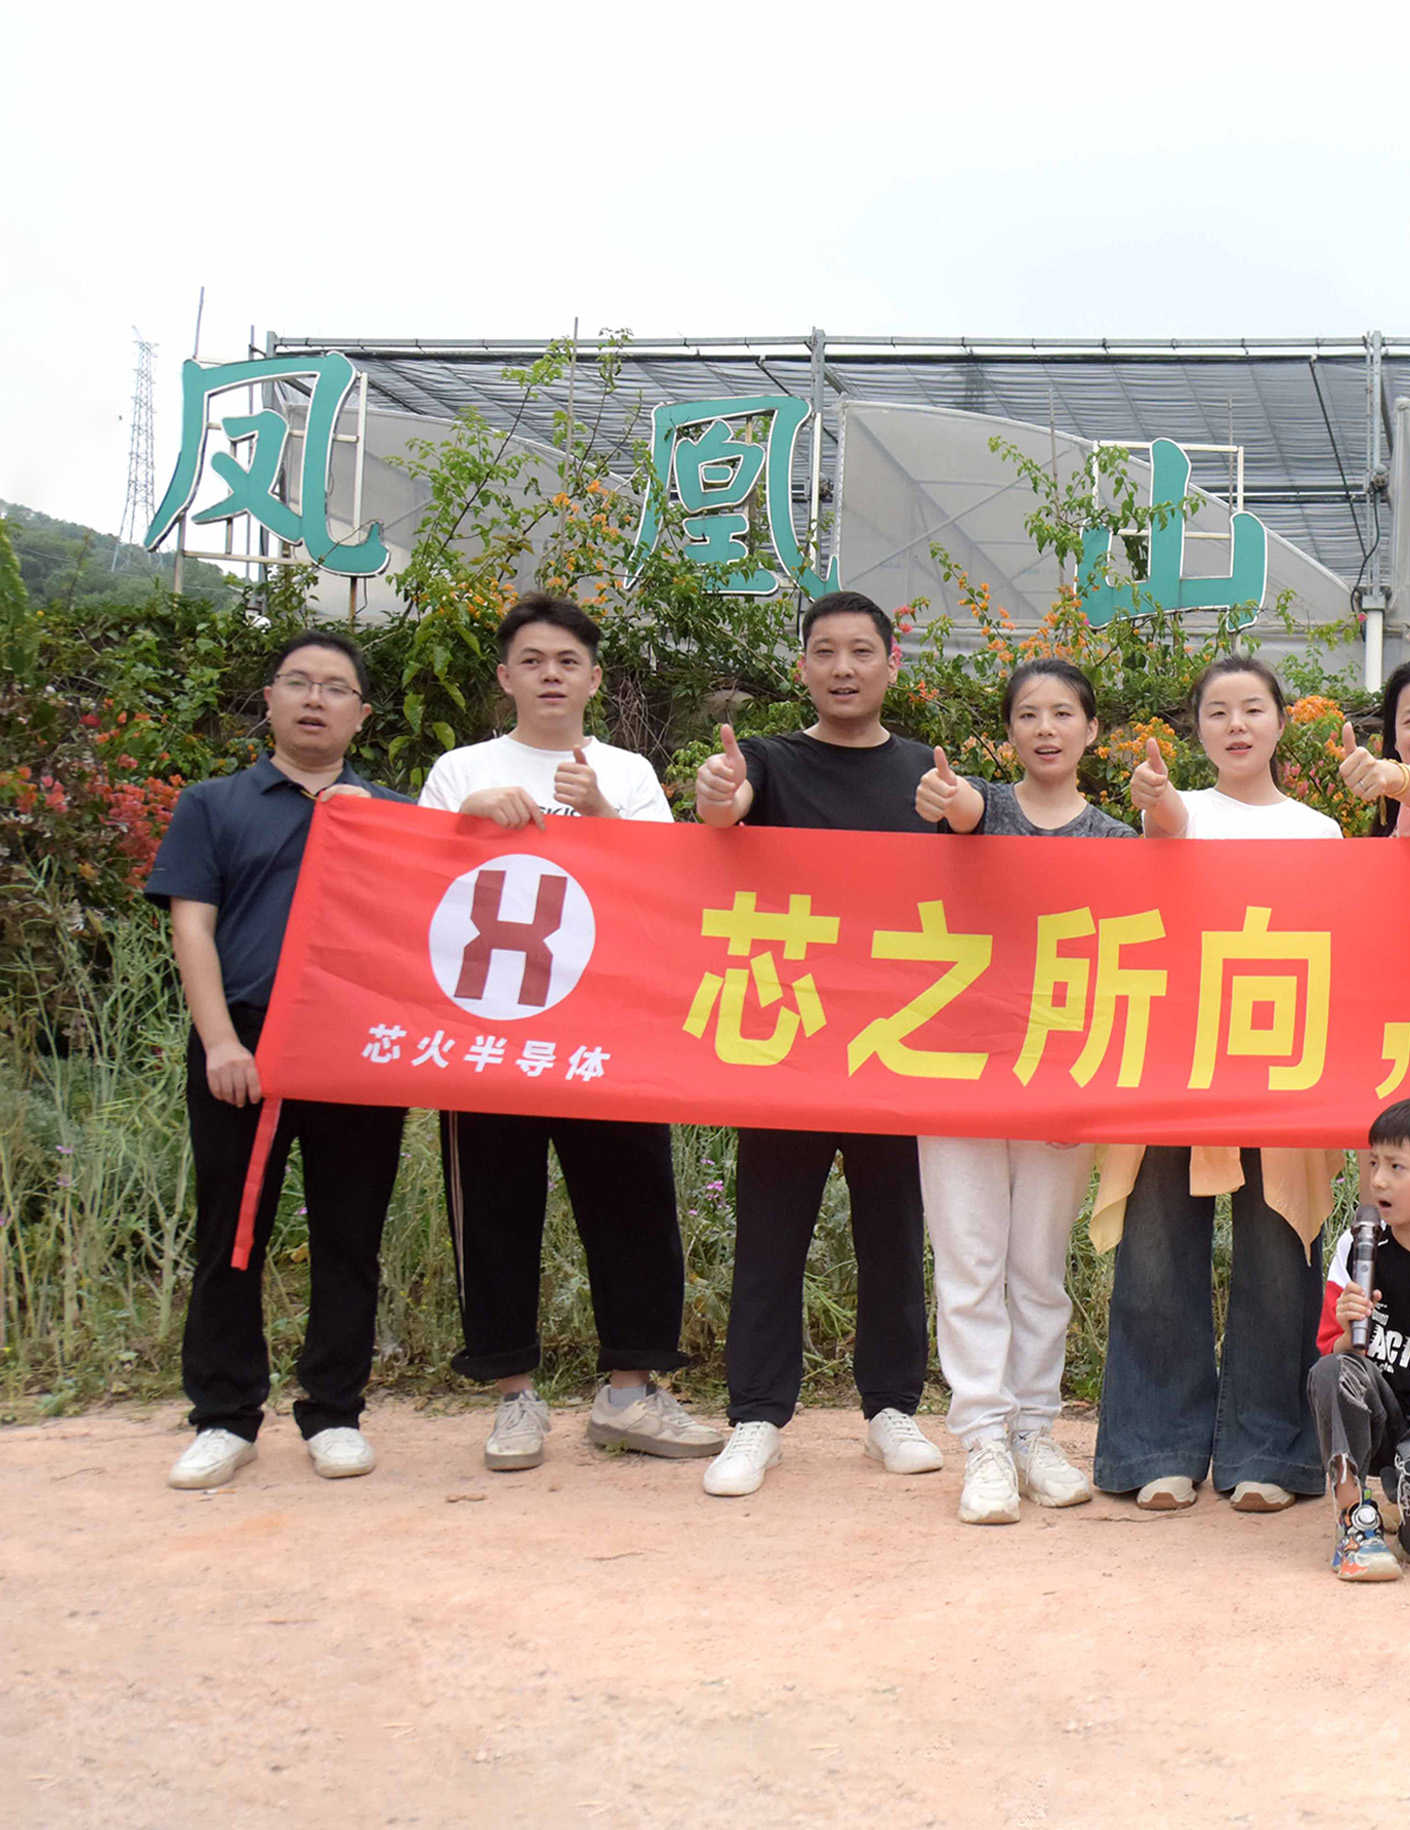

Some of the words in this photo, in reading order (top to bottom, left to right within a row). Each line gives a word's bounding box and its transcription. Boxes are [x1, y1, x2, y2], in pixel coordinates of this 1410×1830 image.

[362, 1023, 611, 1081] 芯火半导体
